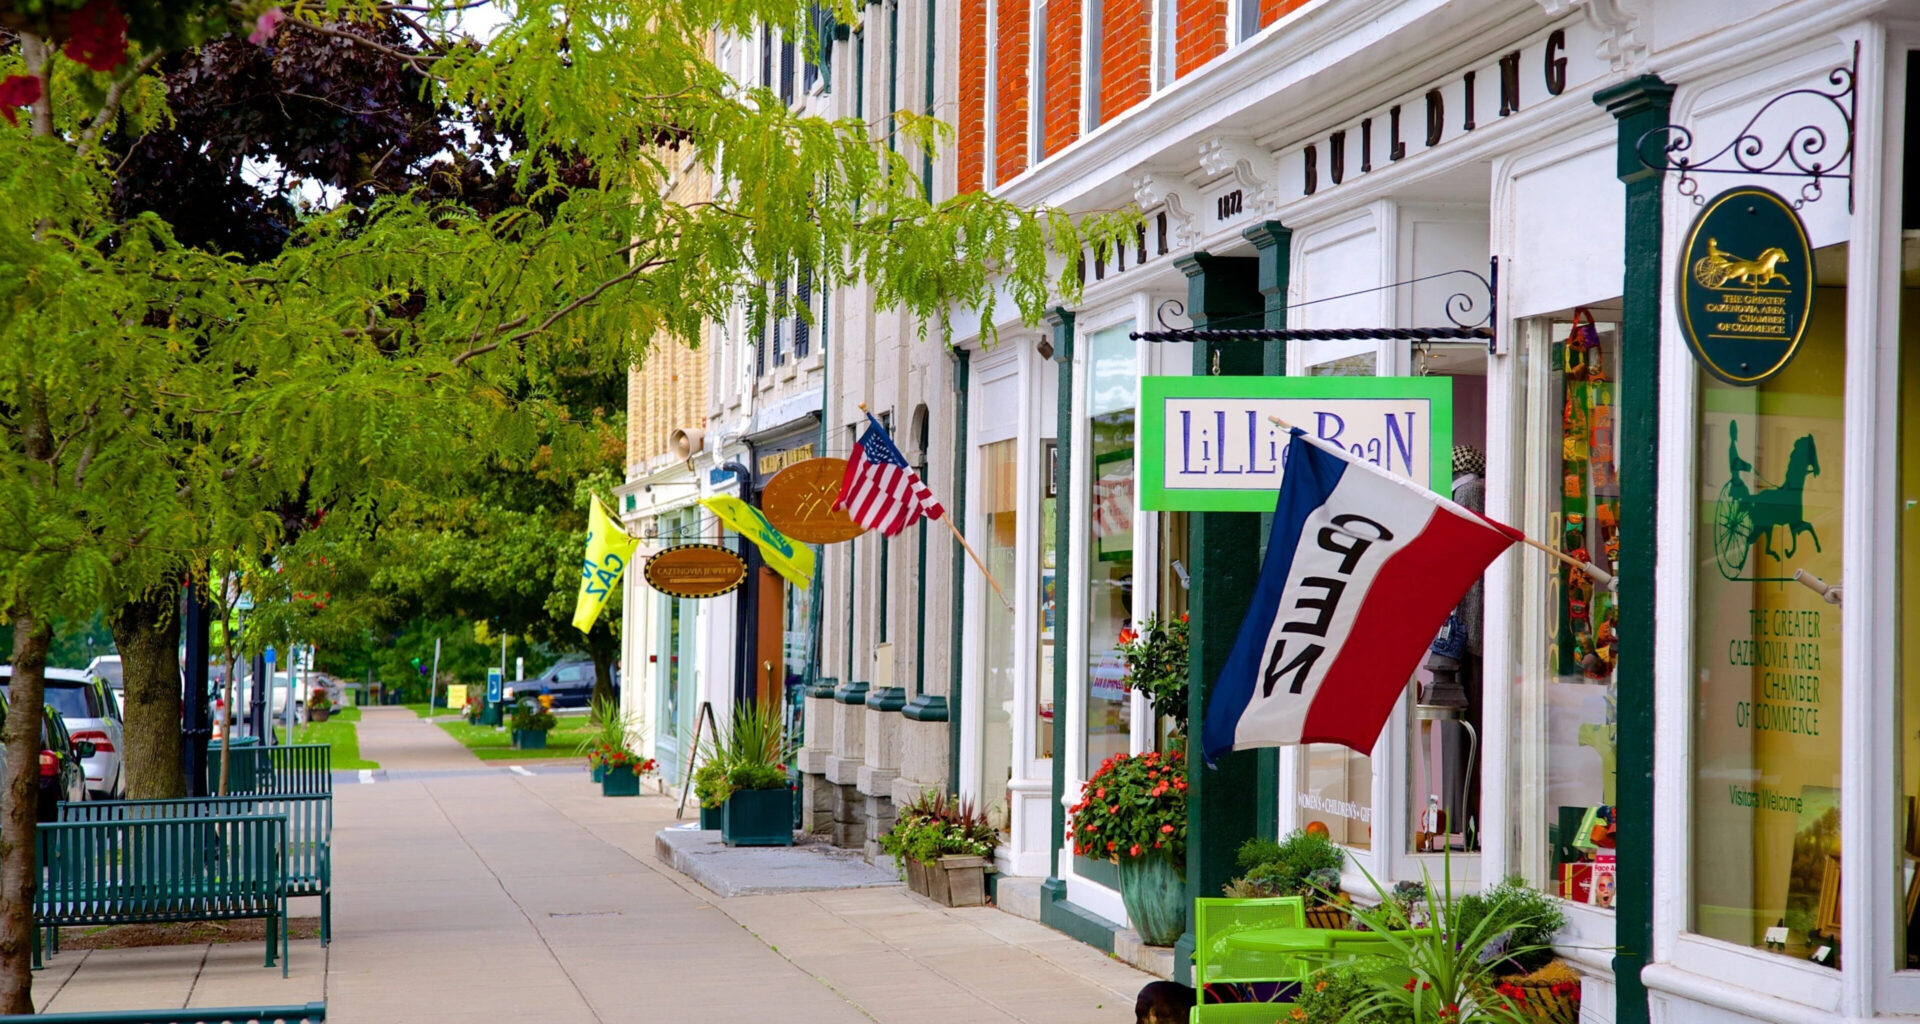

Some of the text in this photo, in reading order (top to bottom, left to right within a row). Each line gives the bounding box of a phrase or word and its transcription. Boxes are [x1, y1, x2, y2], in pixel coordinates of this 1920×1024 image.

[1304, 28, 1568, 195] BUILDING
[1217, 189, 1243, 221] 1872
[1705, 303, 1786, 315] CAZENOVIA AREA
[1722, 294, 1786, 306] THE GREATER
[1717, 322, 1786, 334] OF COMMERCE
[1738, 314, 1785, 325] CHAMBER
[1749, 609, 1821, 638] THE GREATER
[1729, 639, 1821, 671] CAZENOVIA AREA
[1763, 671, 1820, 703] CHAMBER
[1736, 701, 1820, 736] OF COMMERCE
[1728, 784, 1803, 814] Visitors Welcome
